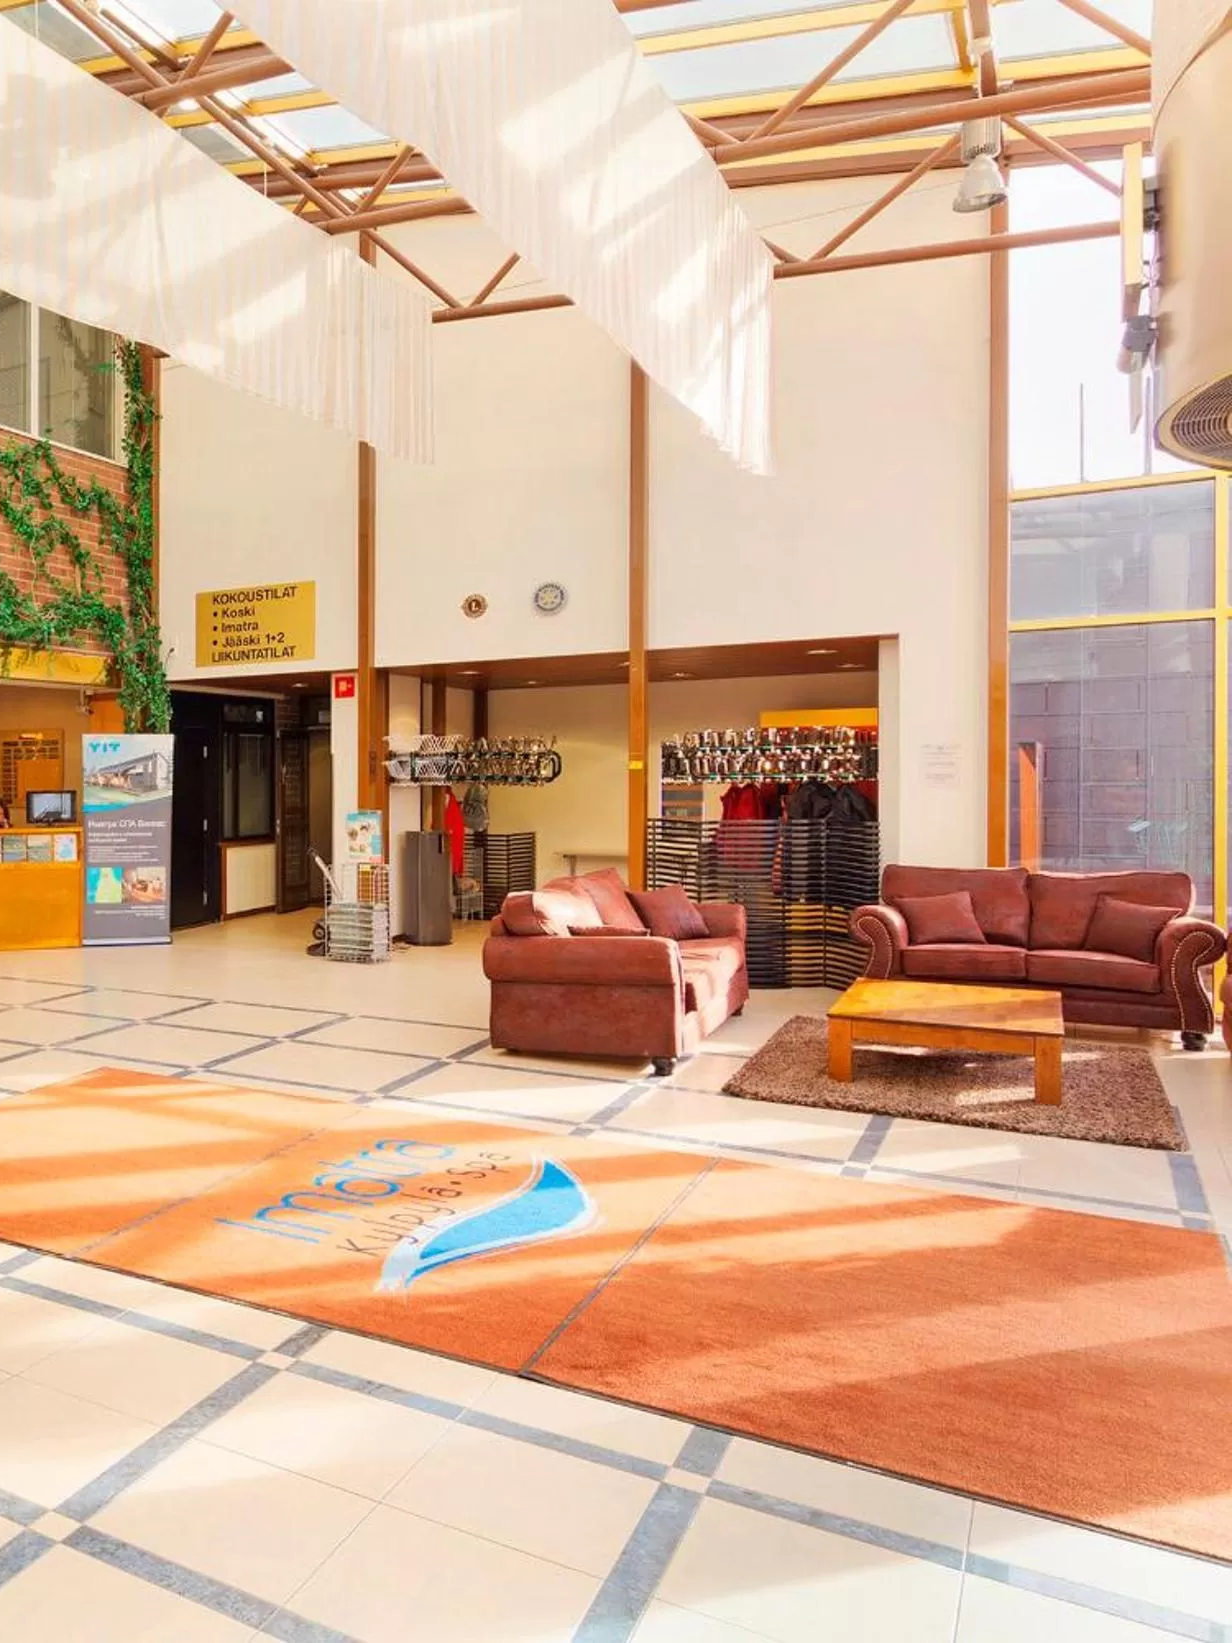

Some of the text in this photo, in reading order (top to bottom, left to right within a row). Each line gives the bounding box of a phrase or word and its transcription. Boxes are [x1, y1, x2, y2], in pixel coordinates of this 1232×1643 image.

[212, 586, 298, 605] KOKOUSTILAT
[221, 606, 255, 619] Koski
[221, 621, 259, 633] Imatra
[221, 634, 260, 648] Jääski
[211, 645, 296, 663] LIIKUNTATILAT
[213, 1139, 456, 1244] Imatra
